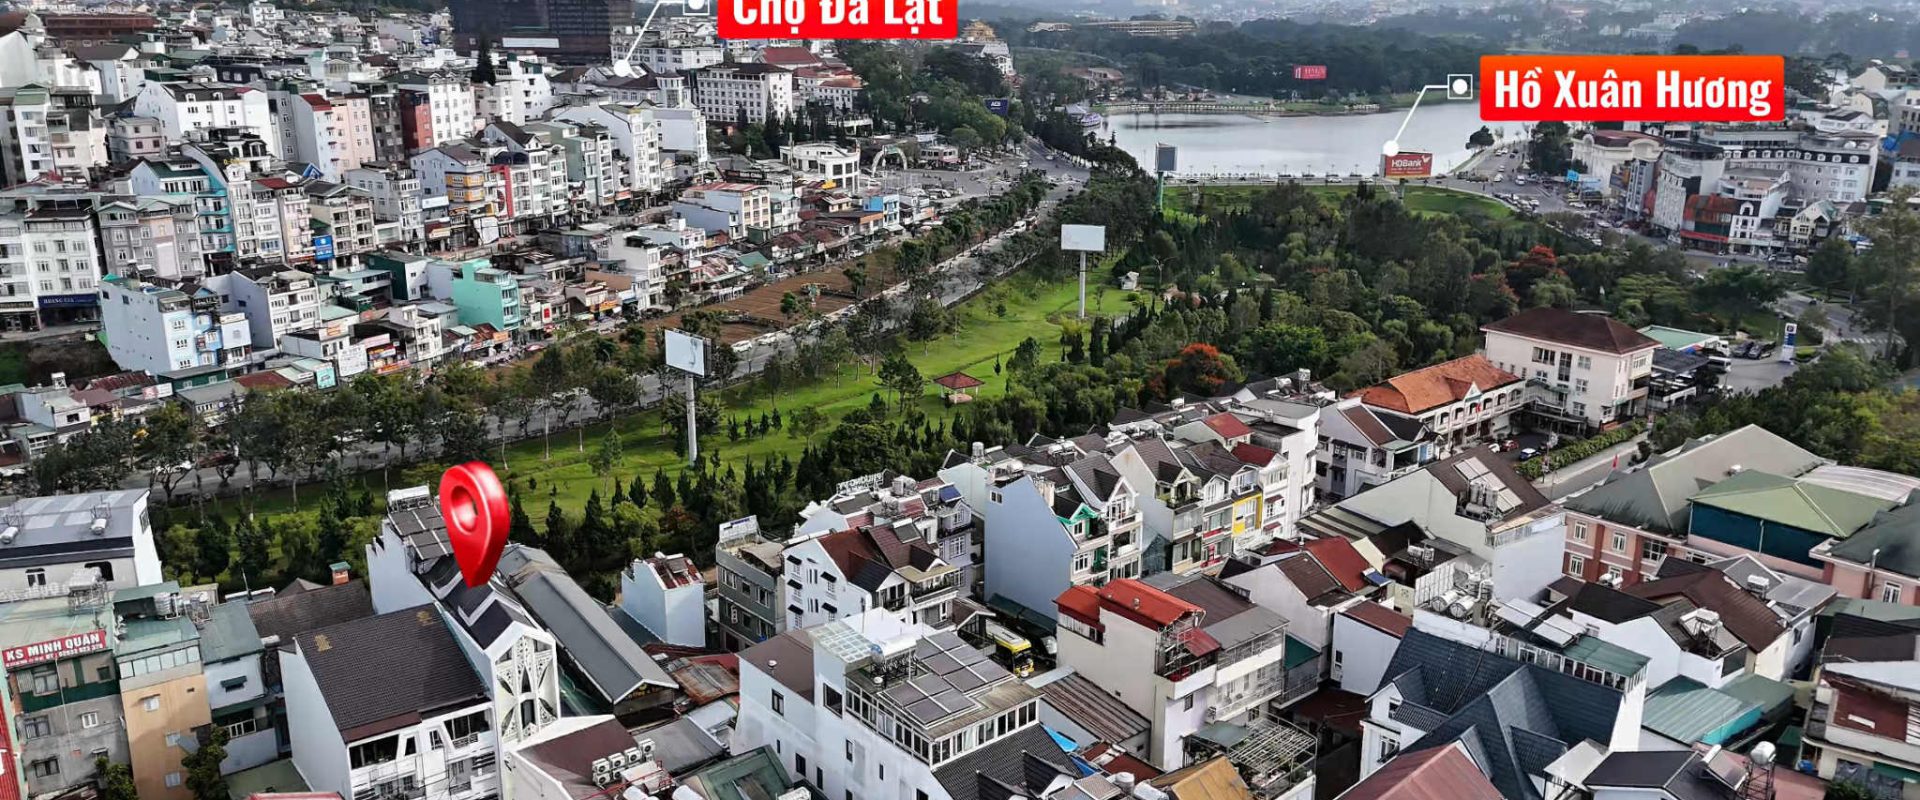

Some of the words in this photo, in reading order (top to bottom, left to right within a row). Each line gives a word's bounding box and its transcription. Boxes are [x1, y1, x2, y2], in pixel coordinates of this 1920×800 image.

[1391, 158, 1422, 168] HDBank
[6, 649, 25, 662] KS
[27, 640, 62, 658] MINH
